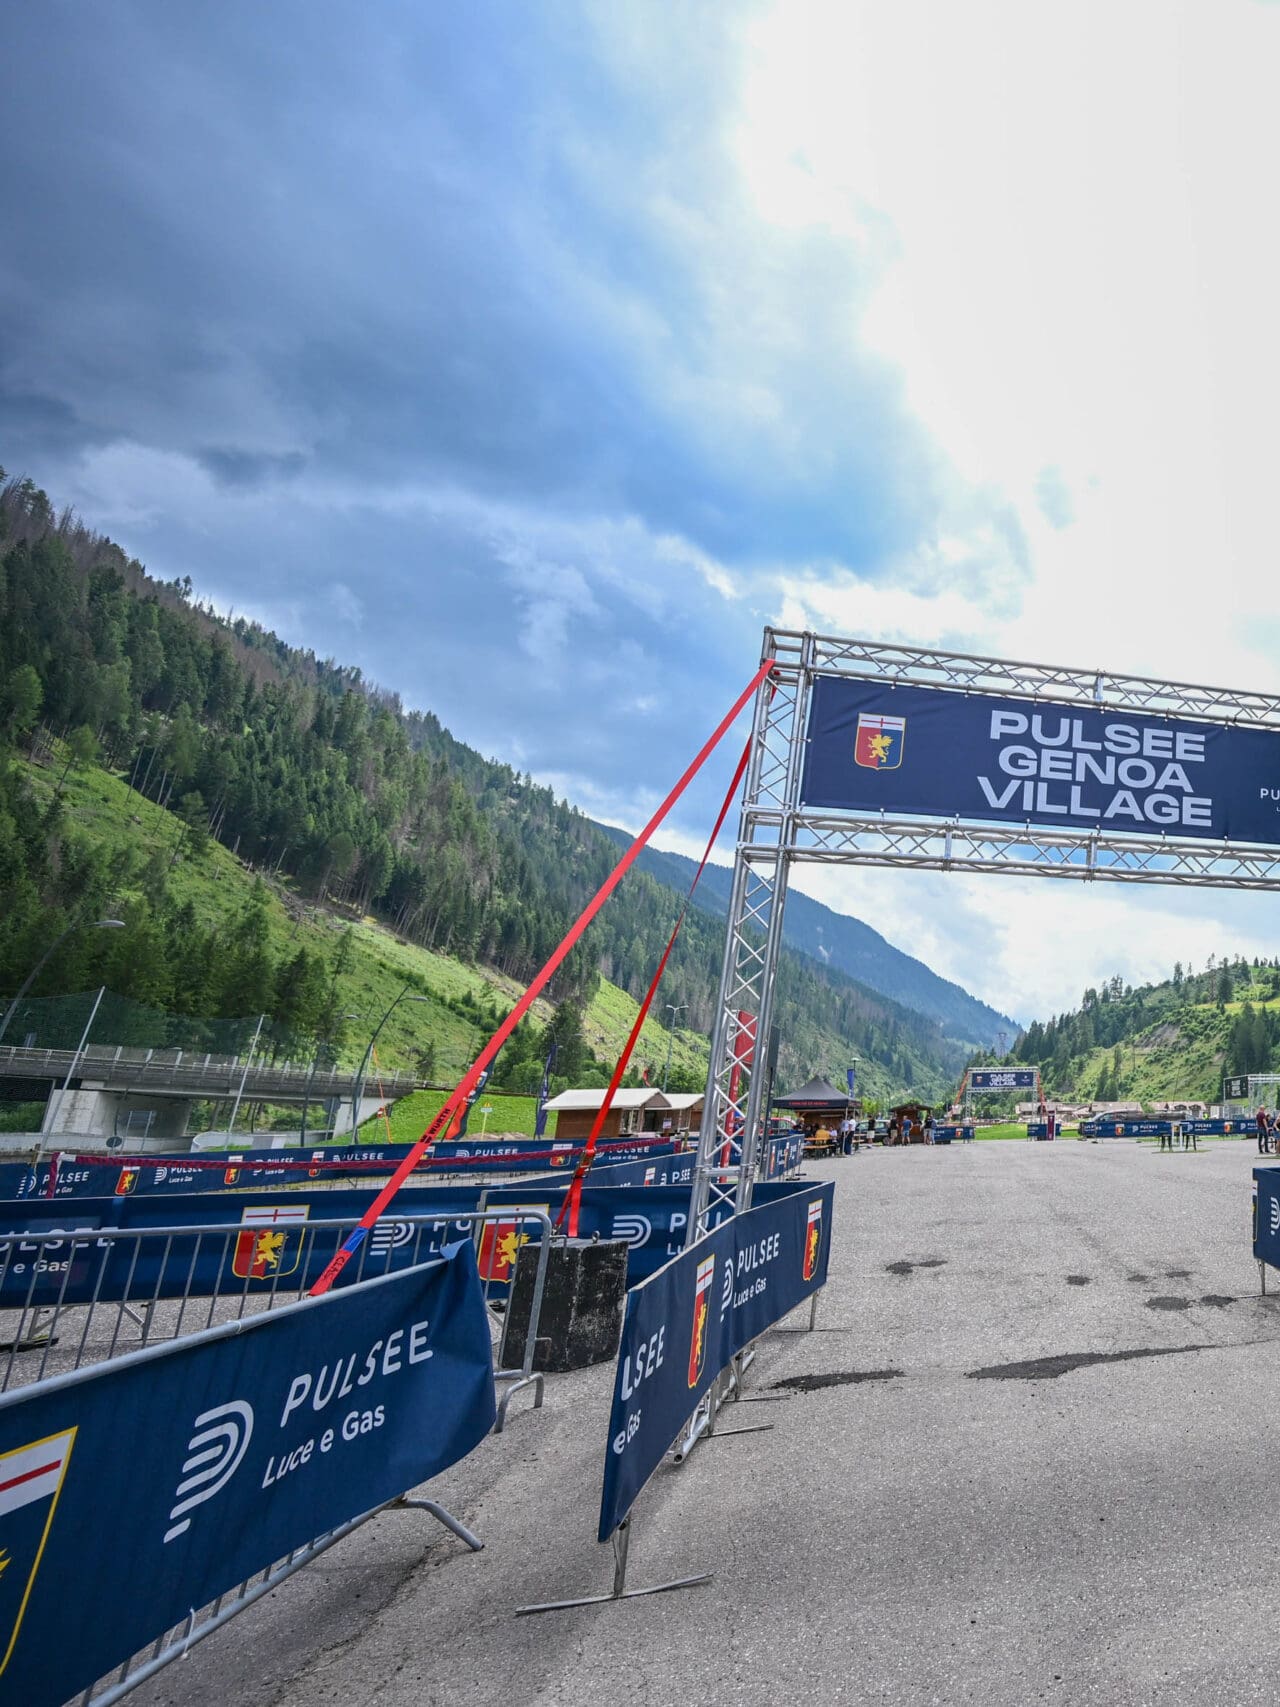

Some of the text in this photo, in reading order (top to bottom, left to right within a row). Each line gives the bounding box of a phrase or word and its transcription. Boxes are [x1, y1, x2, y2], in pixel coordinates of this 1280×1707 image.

[990, 710, 1205, 762] PULSEE
[998, 745, 1194, 793] GENOA
[976, 776, 1212, 827] VILLAGE
[42, 1171, 90, 1185] PLSEE
[343, 1152, 385, 1161] ULSEE
[33, 1259, 70, 1273] Gas
[736, 1232, 780, 1278] PULSEE
[733, 1288, 749, 1309] Luce
[755, 1276, 767, 1296] Gas
[280, 1320, 434, 1428] PULSEE
[261, 1404, 385, 1489] Luce e Gas
[613, 1408, 642, 1455] e Gas
